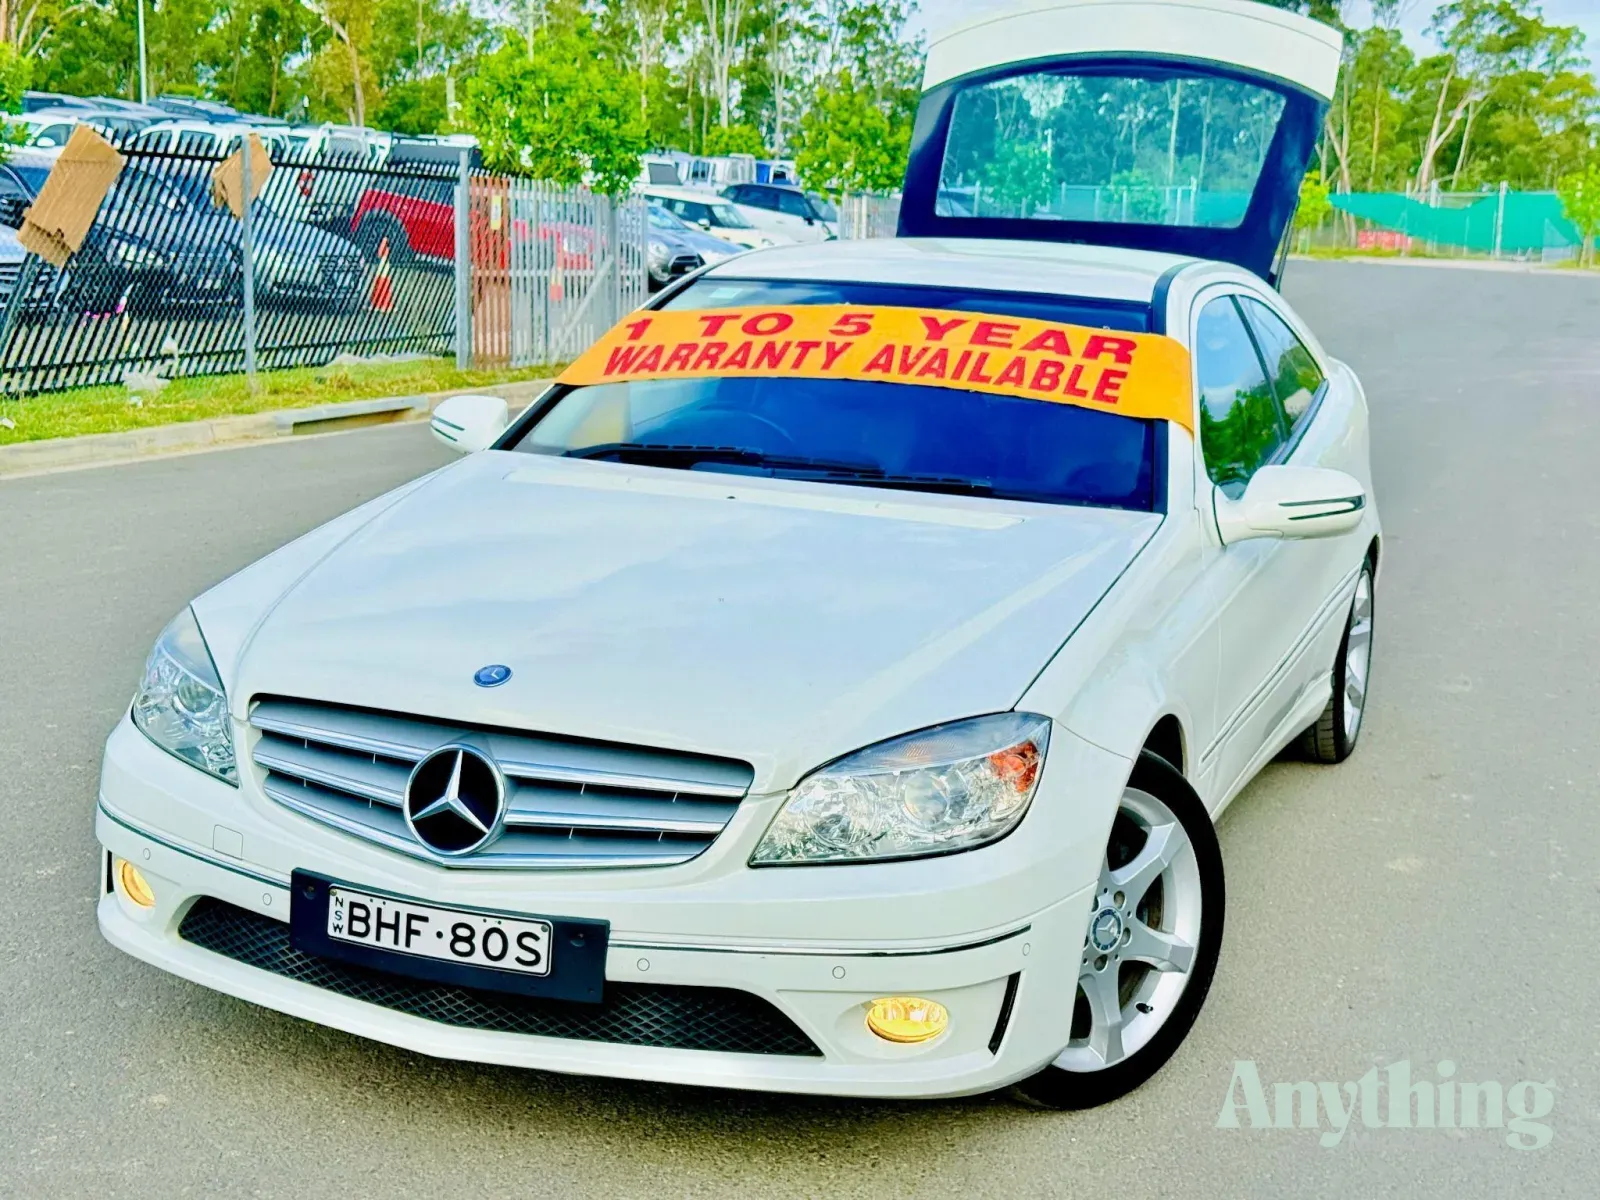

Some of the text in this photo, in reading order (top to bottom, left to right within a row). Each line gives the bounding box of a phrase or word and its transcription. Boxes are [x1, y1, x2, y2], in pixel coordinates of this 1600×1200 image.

[624, 312, 1138, 365] 1 TO 5 YEAR
[603, 341, 1129, 404] WARRANTY AVAILABLE
